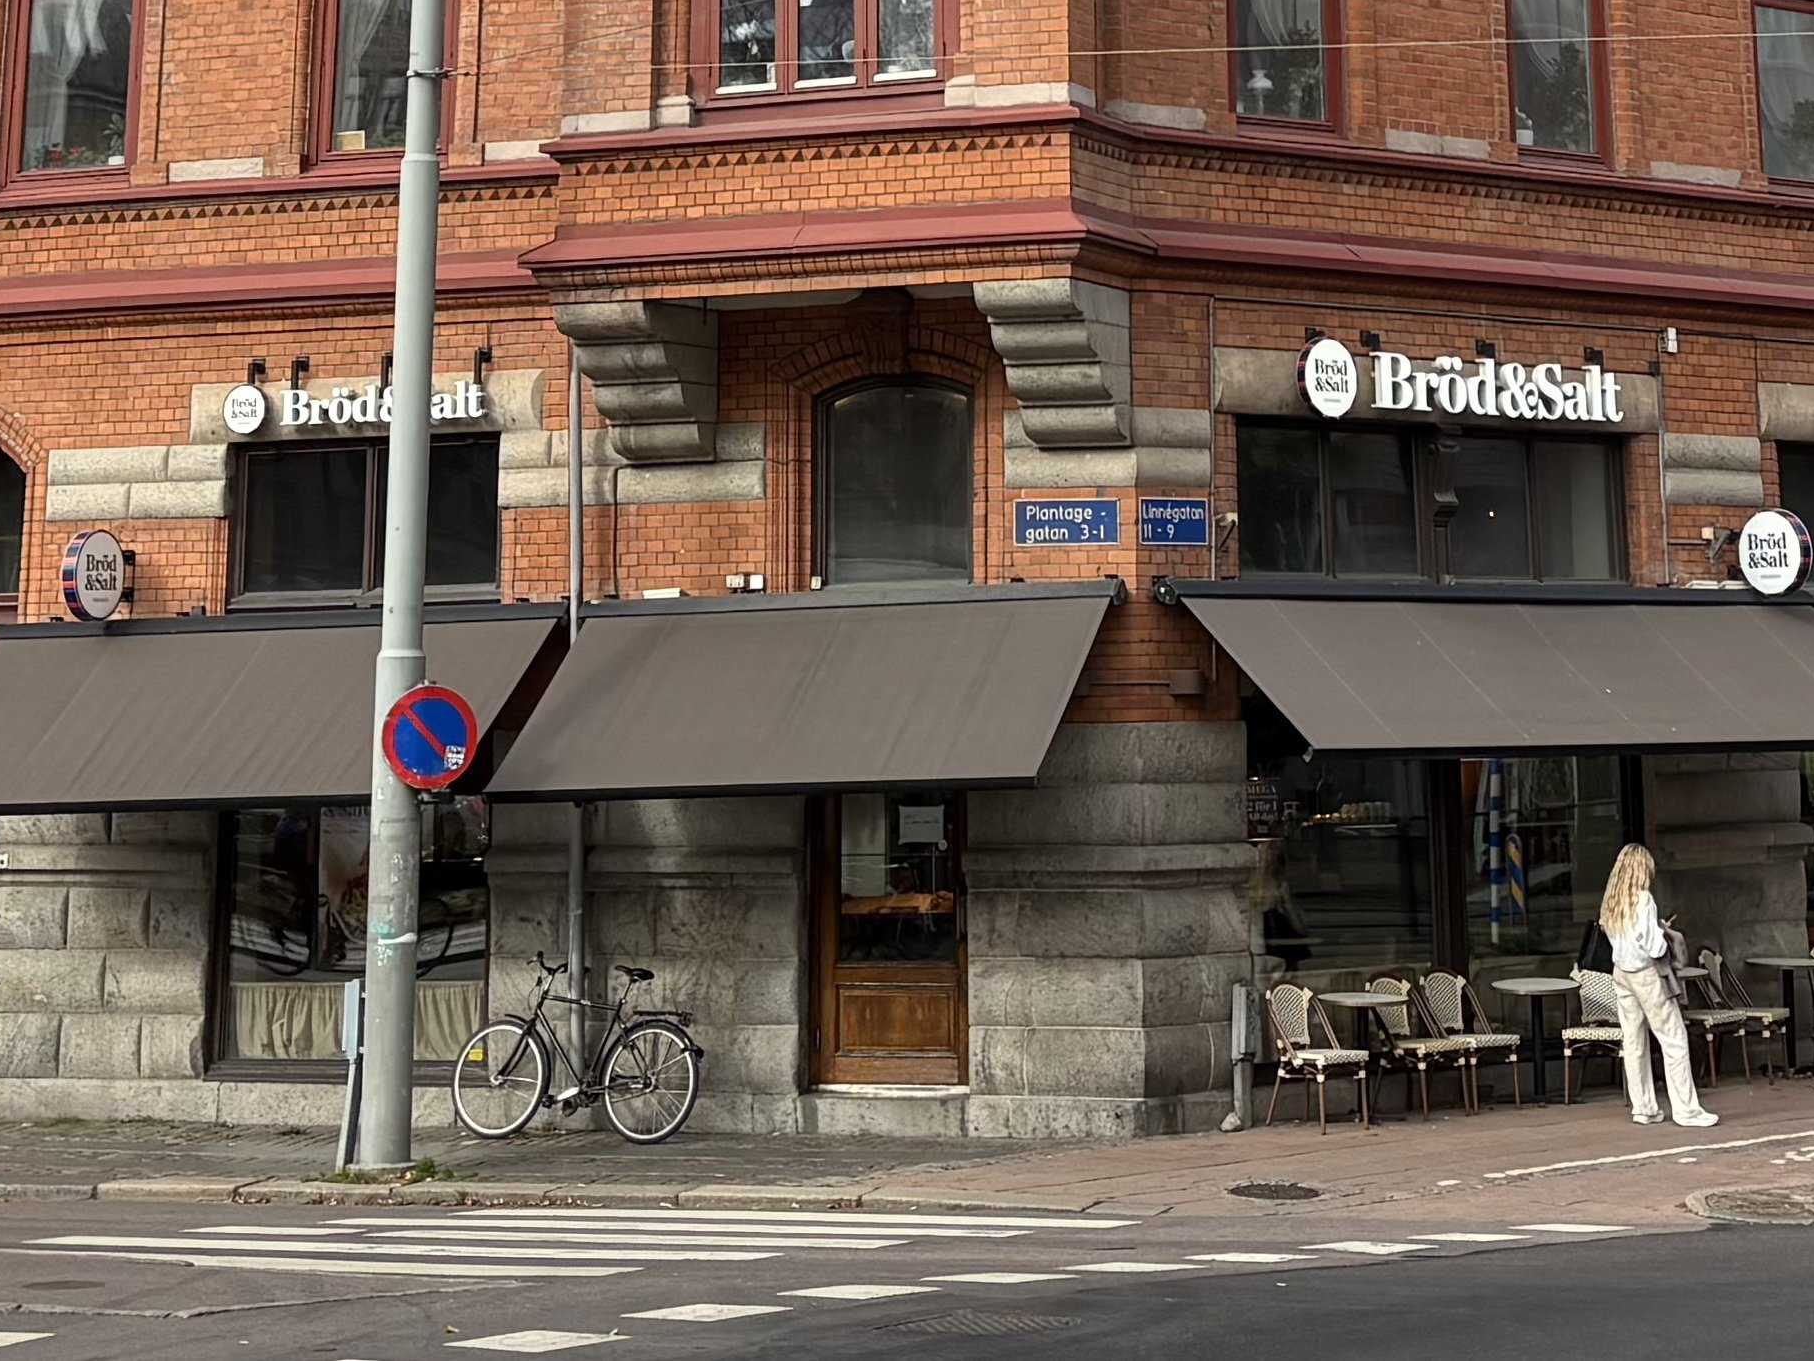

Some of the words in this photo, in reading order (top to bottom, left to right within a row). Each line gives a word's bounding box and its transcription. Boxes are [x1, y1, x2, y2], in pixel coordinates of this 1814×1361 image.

[1314, 358, 1348, 375] Bröd
[1315, 376, 1350, 393] &Salt
[1369, 351, 1624, 423] Bröd&Salt
[280, 381, 488, 426] Bröd&alt
[1026, 505, 1092, 521] Plantage
[1142, 502, 1204, 523] Linnégatan
[1025, 528, 1068, 544] gatan
[1747, 532, 1787, 551] Bröd
[86, 554, 117, 572] Bröd
[1748, 550, 1789, 570] &Salt
[85, 573, 117, 591] &Salt
